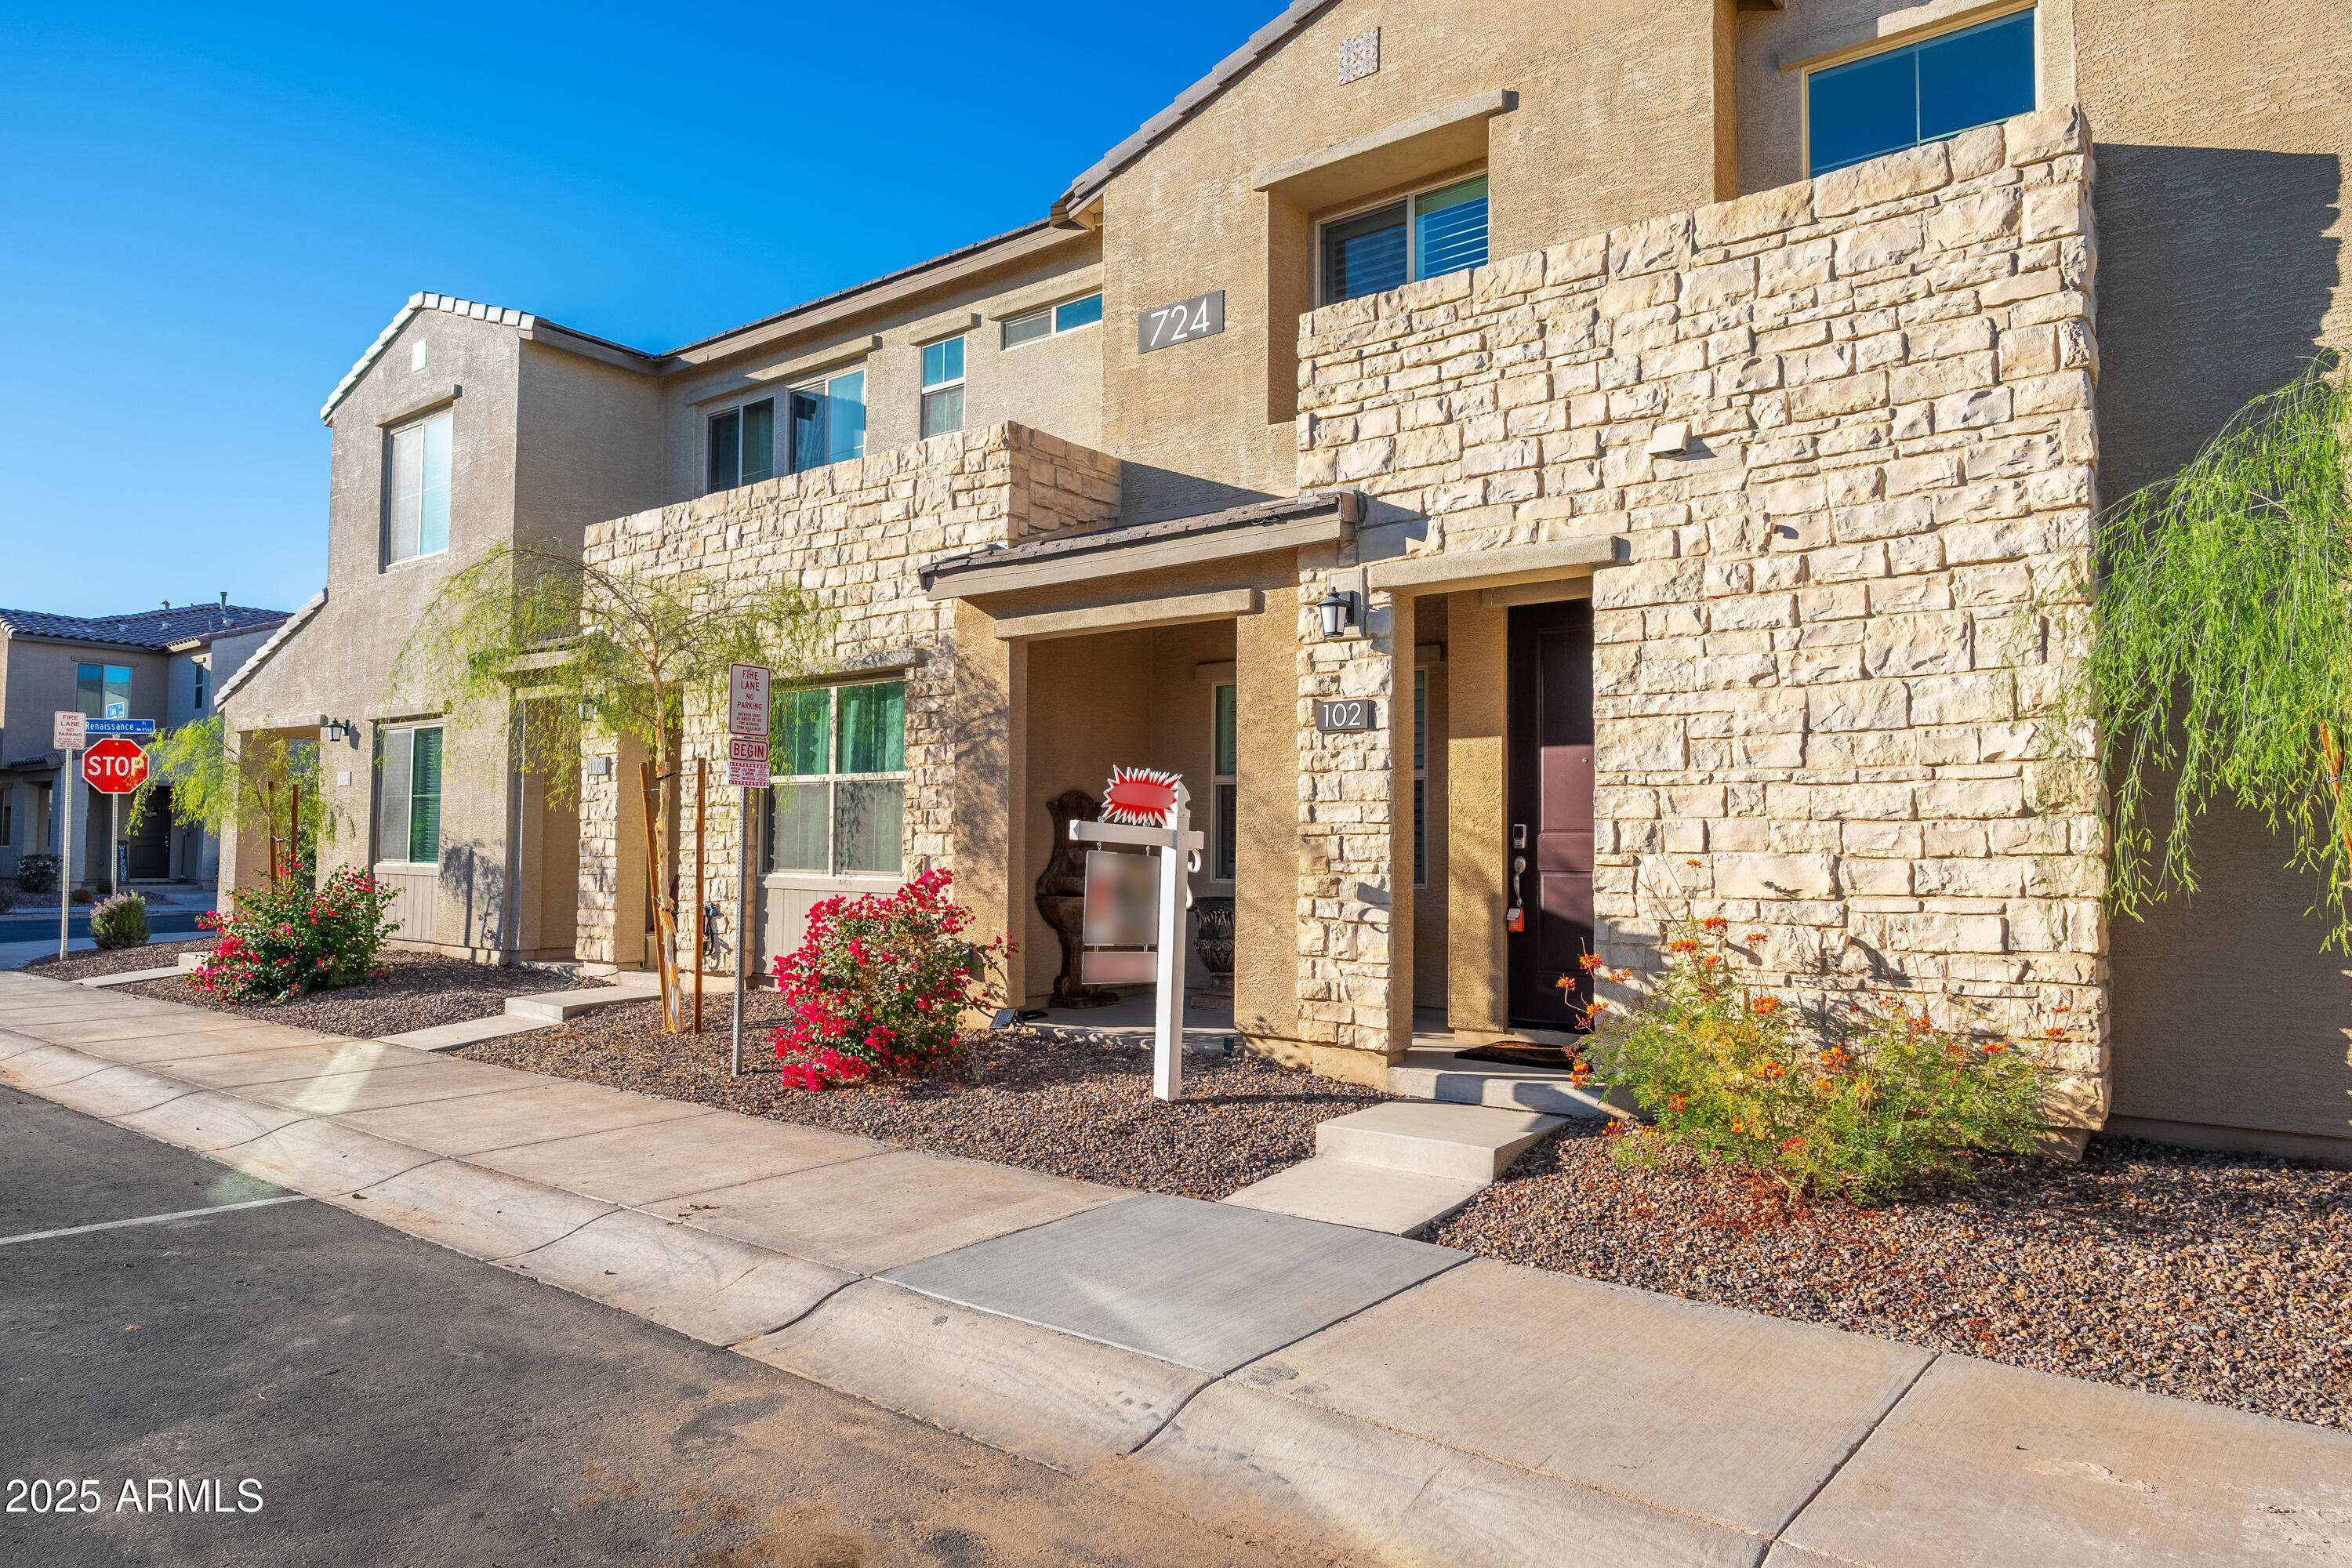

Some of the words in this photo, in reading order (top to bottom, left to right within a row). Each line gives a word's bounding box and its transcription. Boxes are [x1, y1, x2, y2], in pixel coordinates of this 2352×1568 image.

[1150, 296, 1210, 347] 724
[742, 670, 759, 681] FIRE
[741, 681, 760, 691] LANE
[737, 702, 762, 710] PARKING
[1323, 702, 1361, 728] 102
[85, 721, 134, 731] Renaissance
[734, 743, 764, 757] BEGIN
[88, 756, 144, 776] STOP
[589, 758, 604, 773] 103
[118, 845, 127, 882] WELCOME
